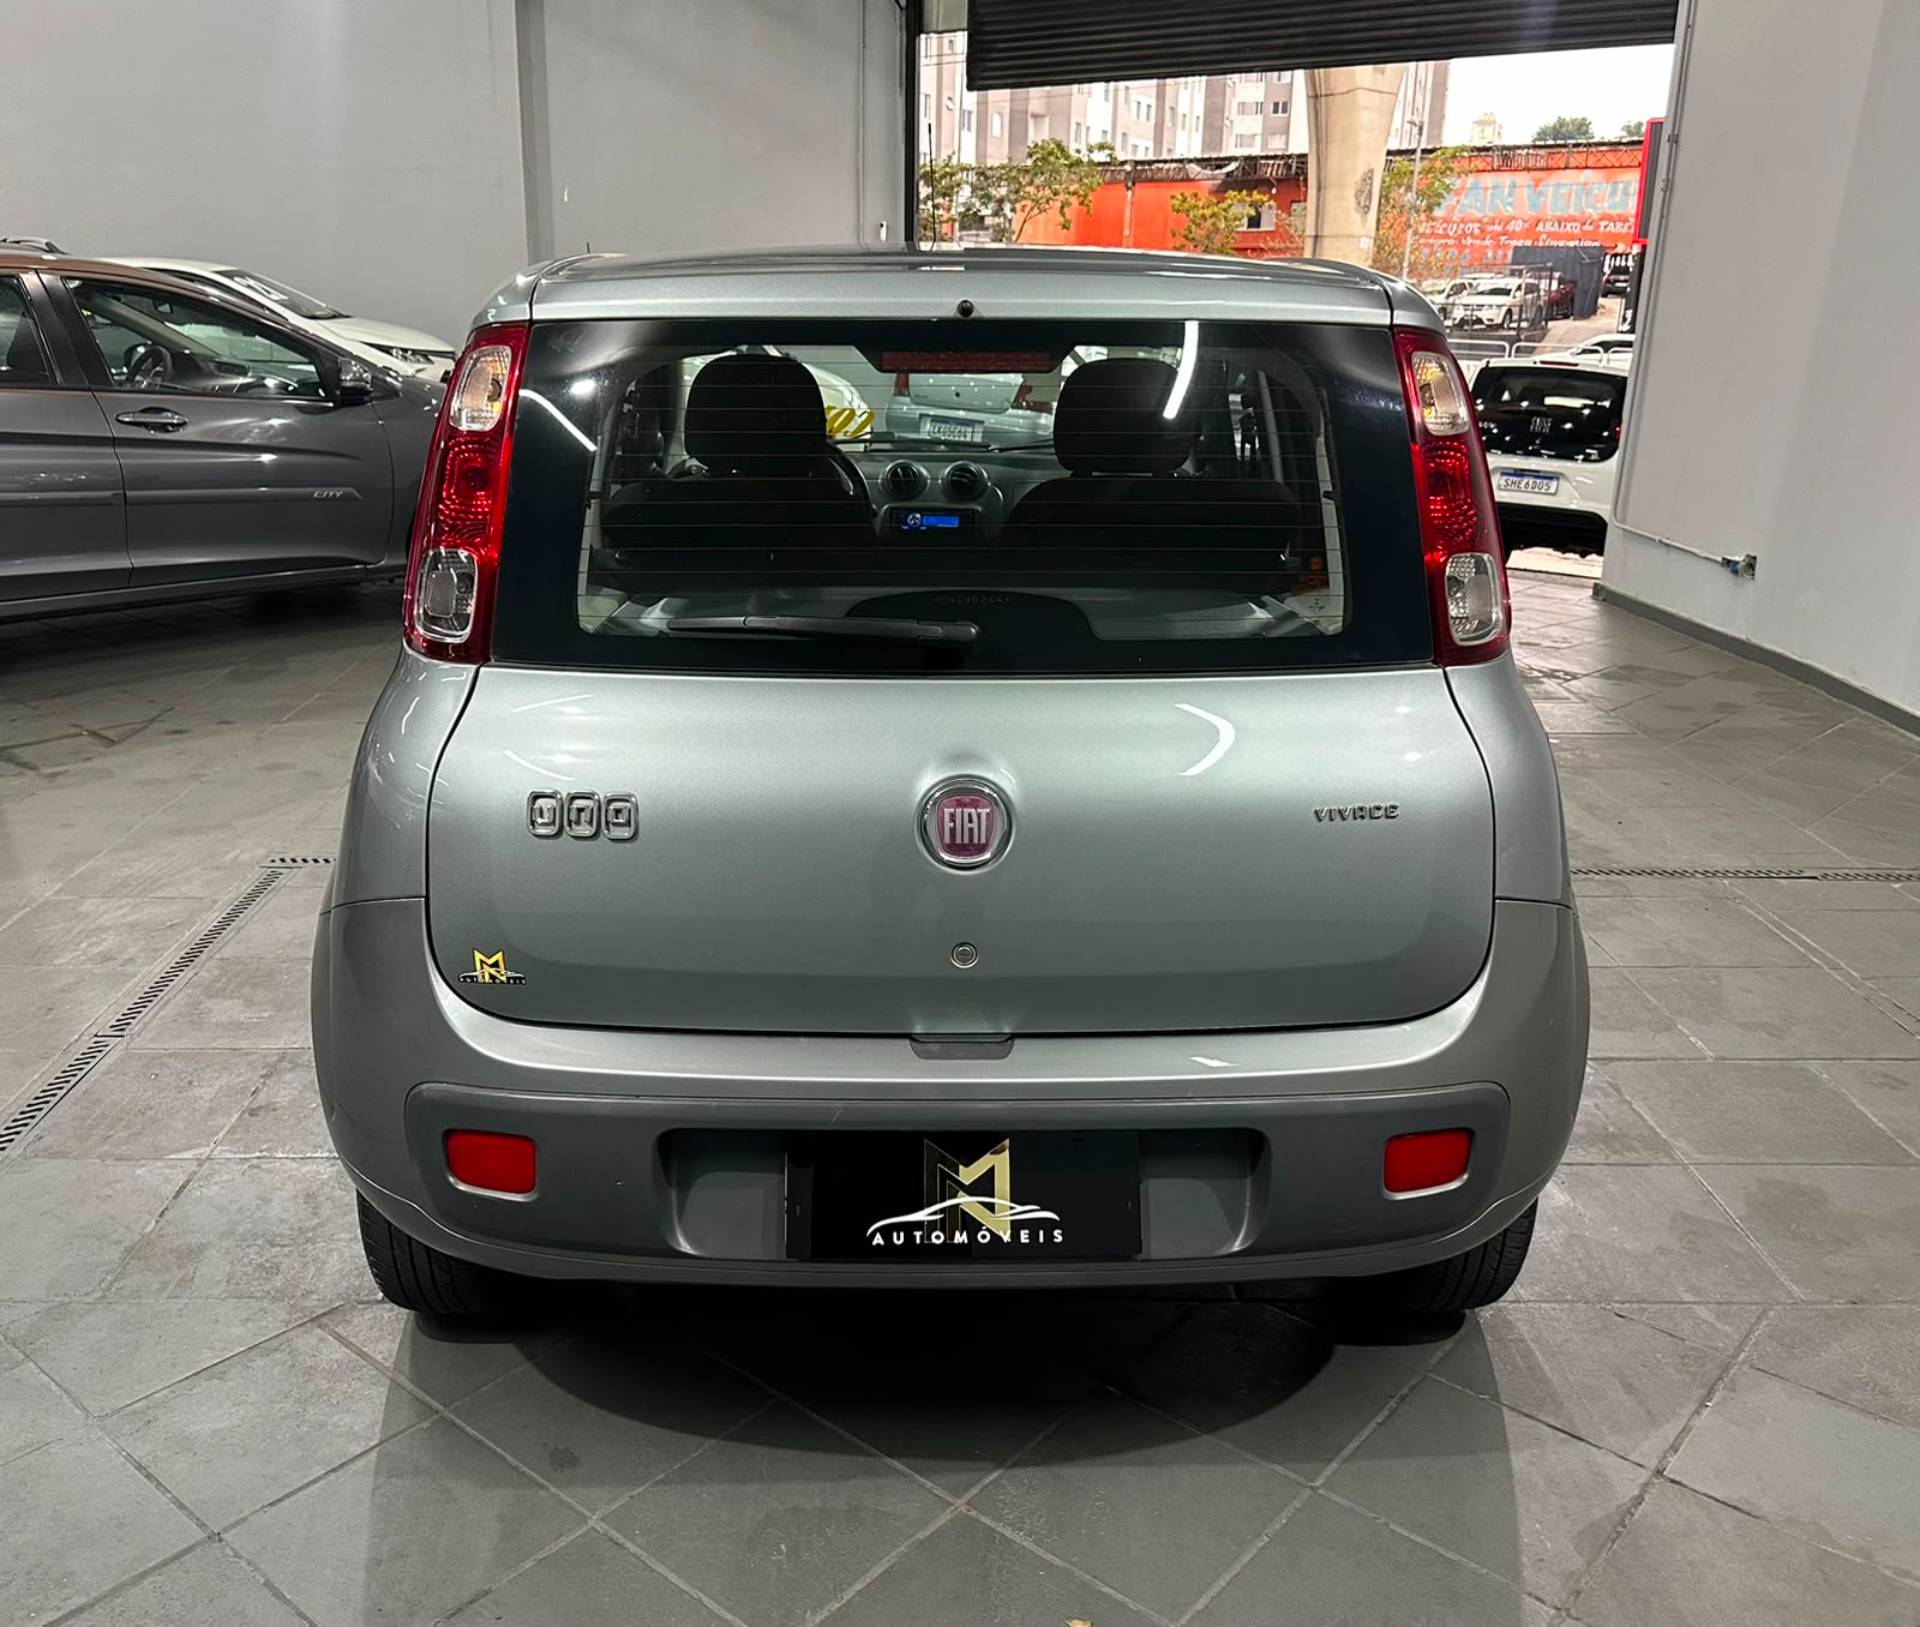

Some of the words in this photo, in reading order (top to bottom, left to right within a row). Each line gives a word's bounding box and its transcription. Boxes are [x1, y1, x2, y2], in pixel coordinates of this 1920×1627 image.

[1536, 220, 1580, 233] ABAIXO
[1313, 803, 1399, 823] VIVACE
[943, 807, 991, 844] FIAT
[872, 1226, 1063, 1246] AUTOMÓVEIS
